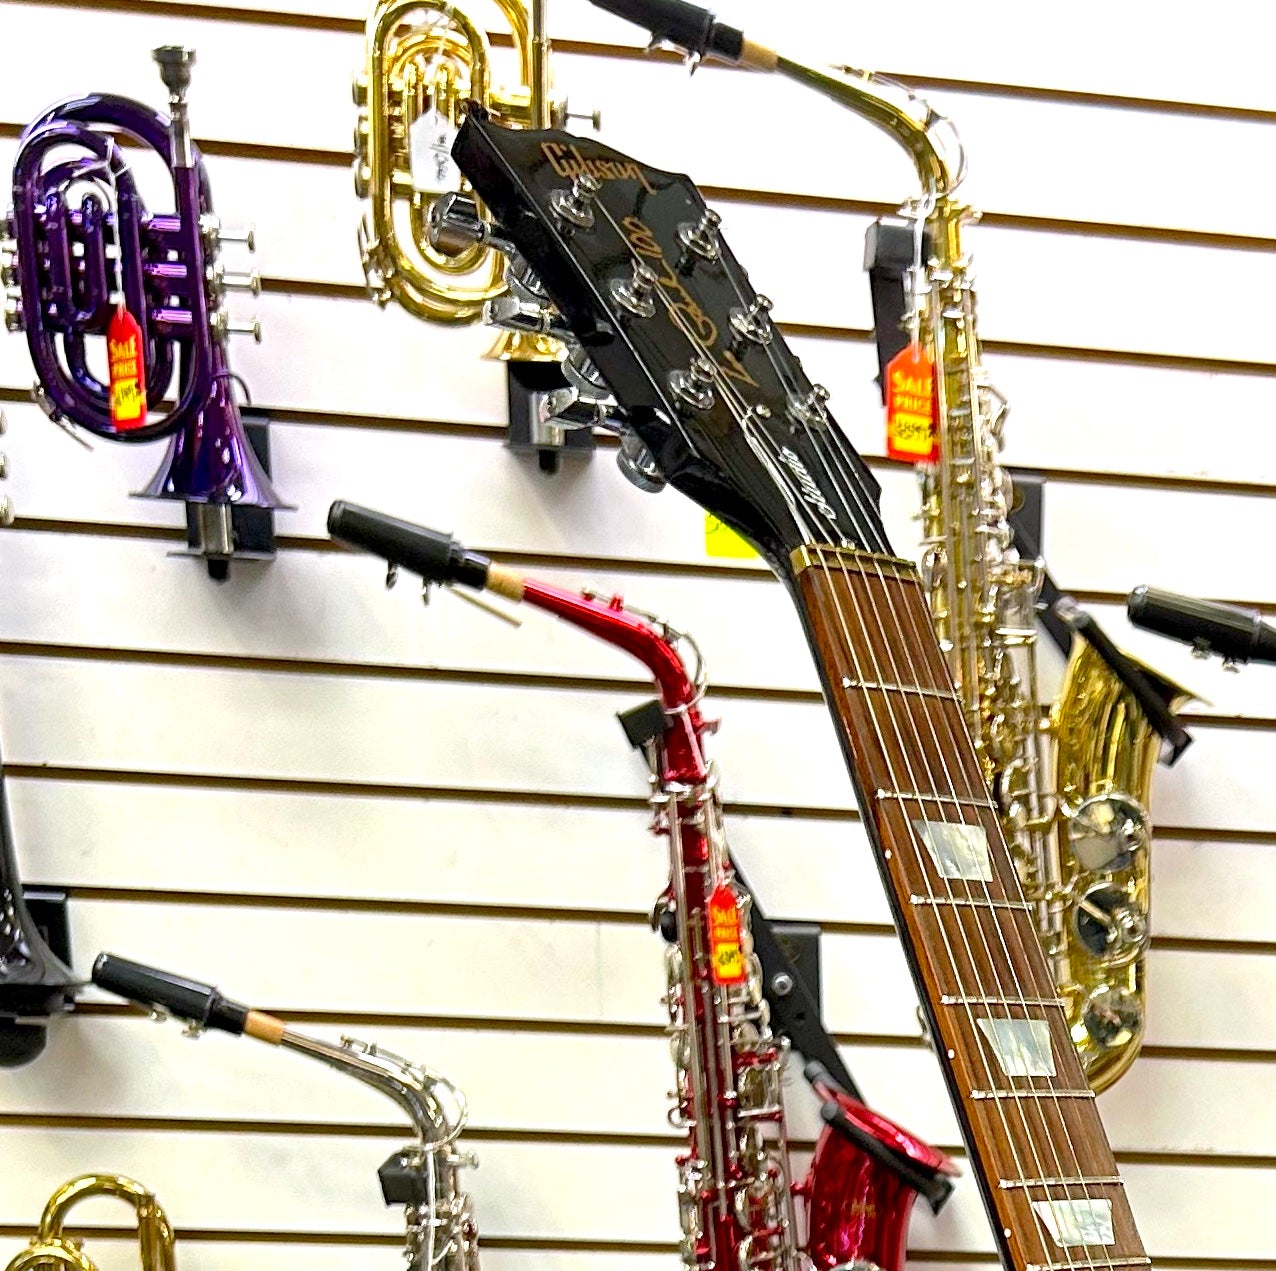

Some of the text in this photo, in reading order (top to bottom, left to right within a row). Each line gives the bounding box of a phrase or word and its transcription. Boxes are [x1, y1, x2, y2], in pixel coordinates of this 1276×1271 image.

[541, 140, 657, 196] Gibson
[892, 370, 932, 397] SALE
[893, 394, 931, 415] PRICE
[779, 446, 838, 520] Studio
